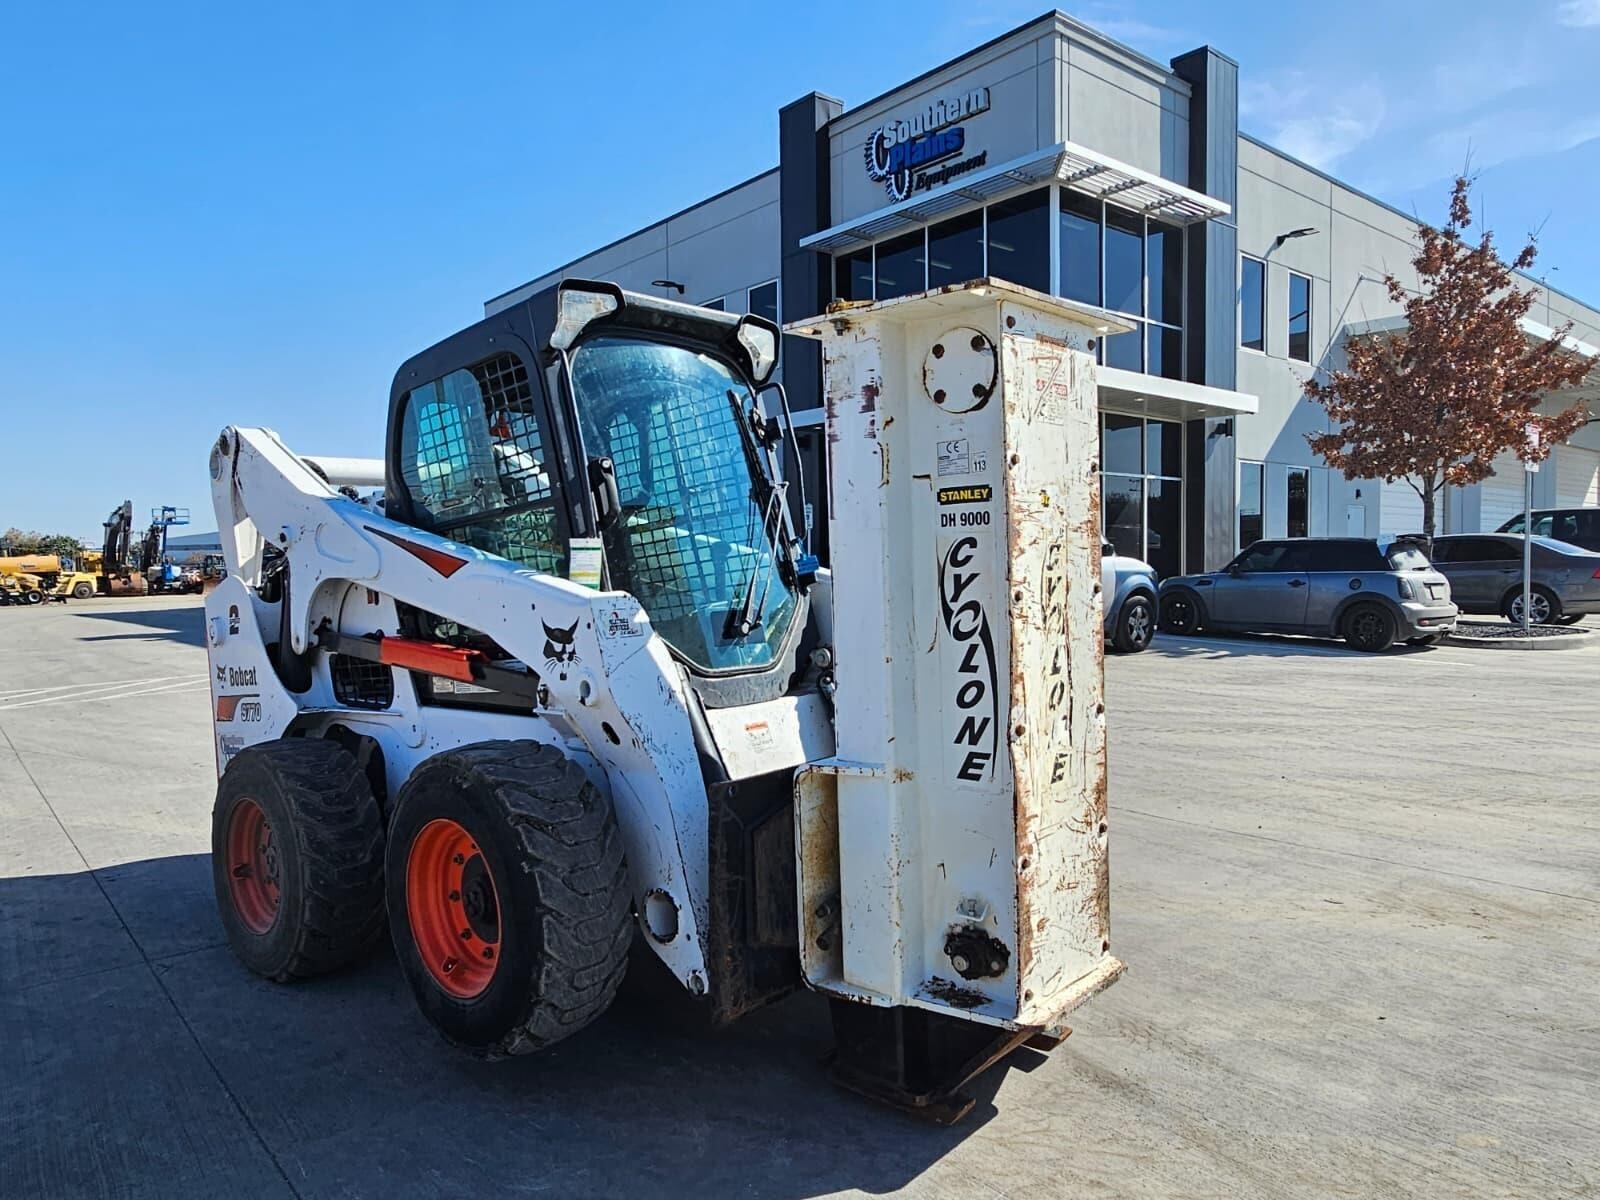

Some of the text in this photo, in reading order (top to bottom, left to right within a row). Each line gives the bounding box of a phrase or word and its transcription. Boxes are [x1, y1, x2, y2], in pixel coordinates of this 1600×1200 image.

[882, 87, 991, 149] Southern
[889, 127, 965, 173] Plains
[914, 149, 988, 192] Equipment
[973, 459, 987, 471] 113
[940, 488, 989, 502] STANLEY
[940, 510, 990, 528] DH 9000
[229, 665, 257, 687] Bobcat
